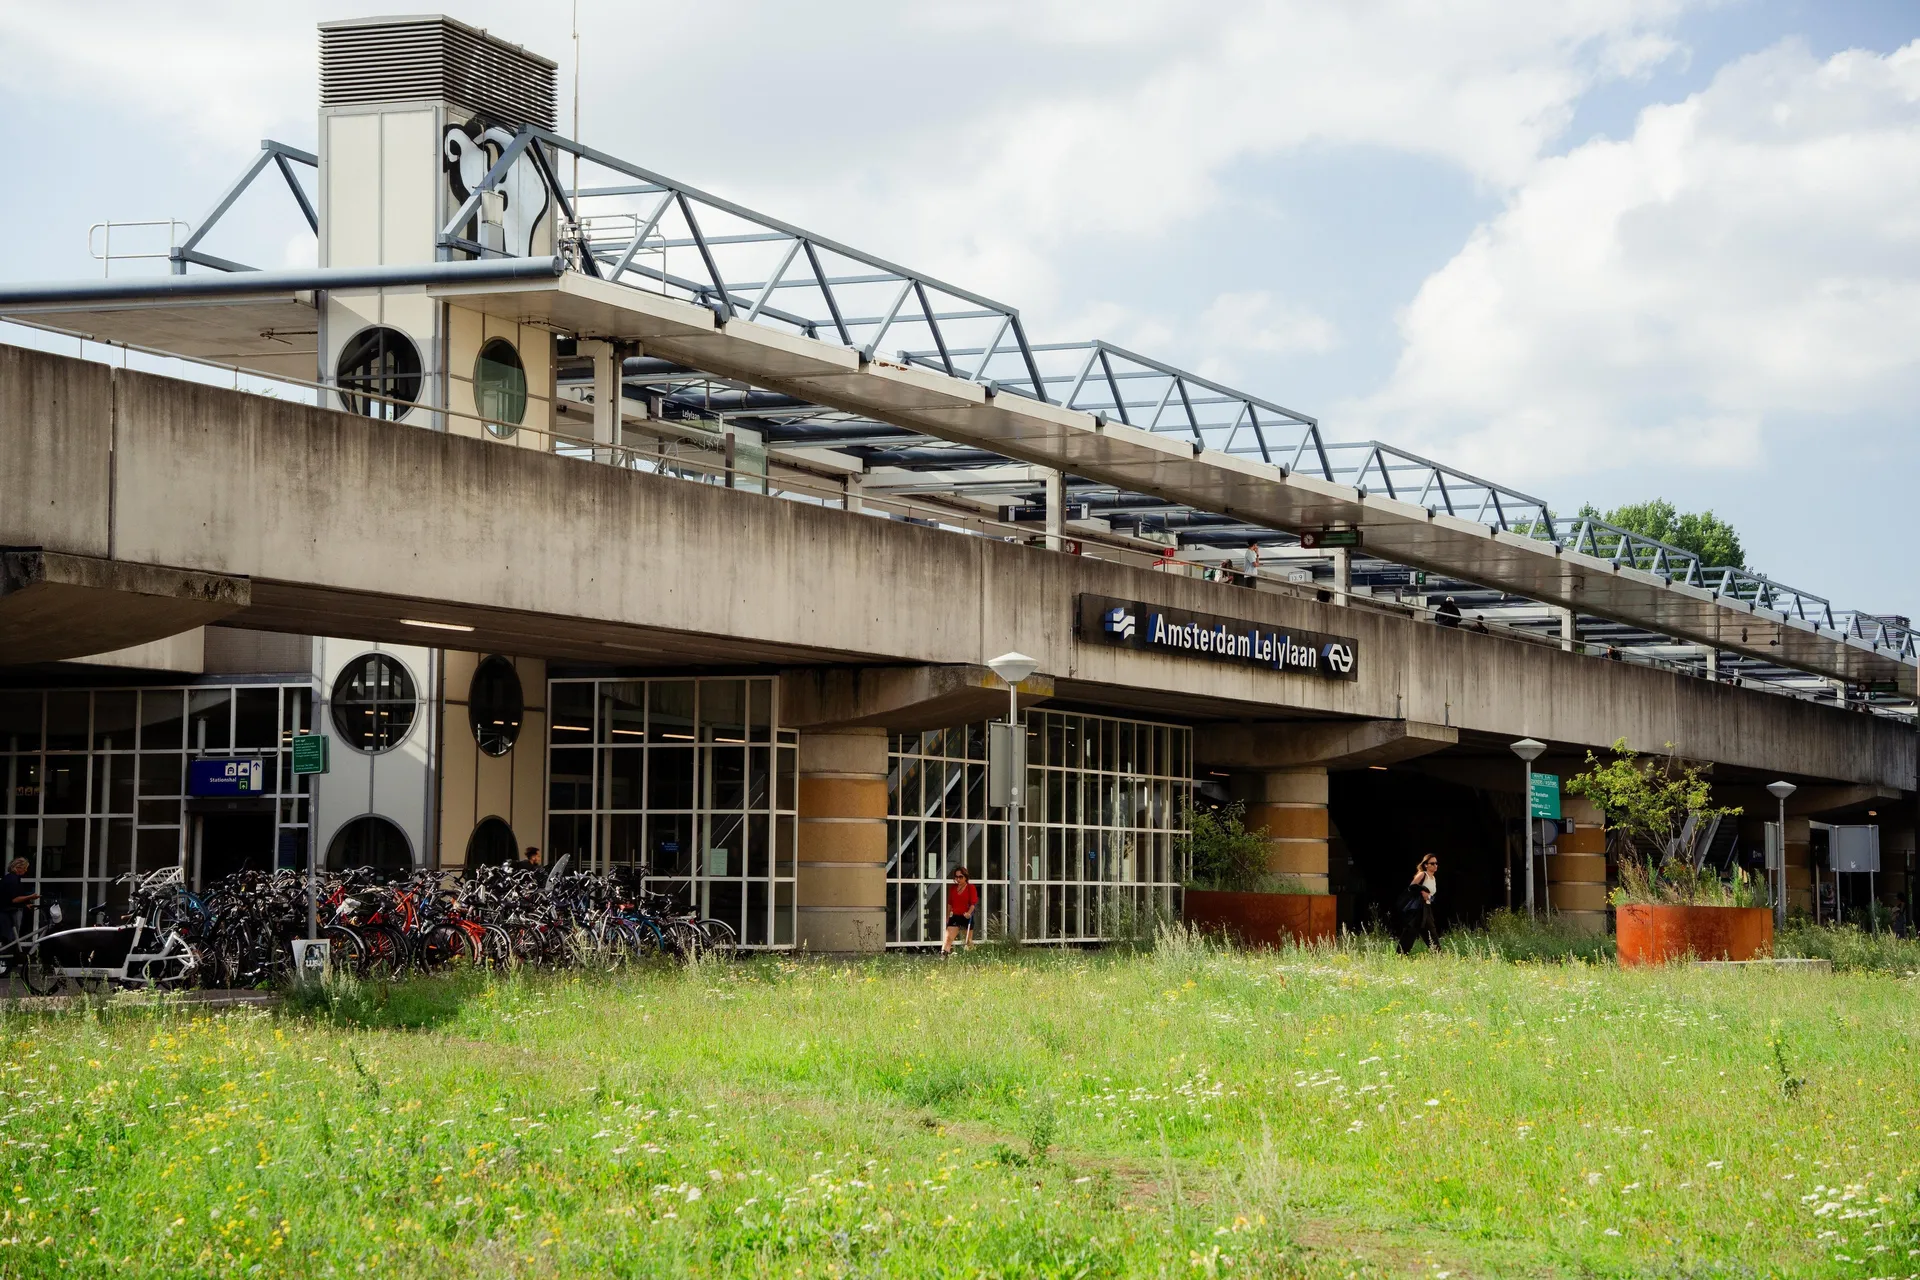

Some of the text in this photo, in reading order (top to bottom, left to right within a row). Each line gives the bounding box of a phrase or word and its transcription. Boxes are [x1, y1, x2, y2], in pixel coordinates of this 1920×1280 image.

[682, 409, 701, 420] Lelylaan
[1154, 613, 1316, 669] Amsterdam Lelylaan
